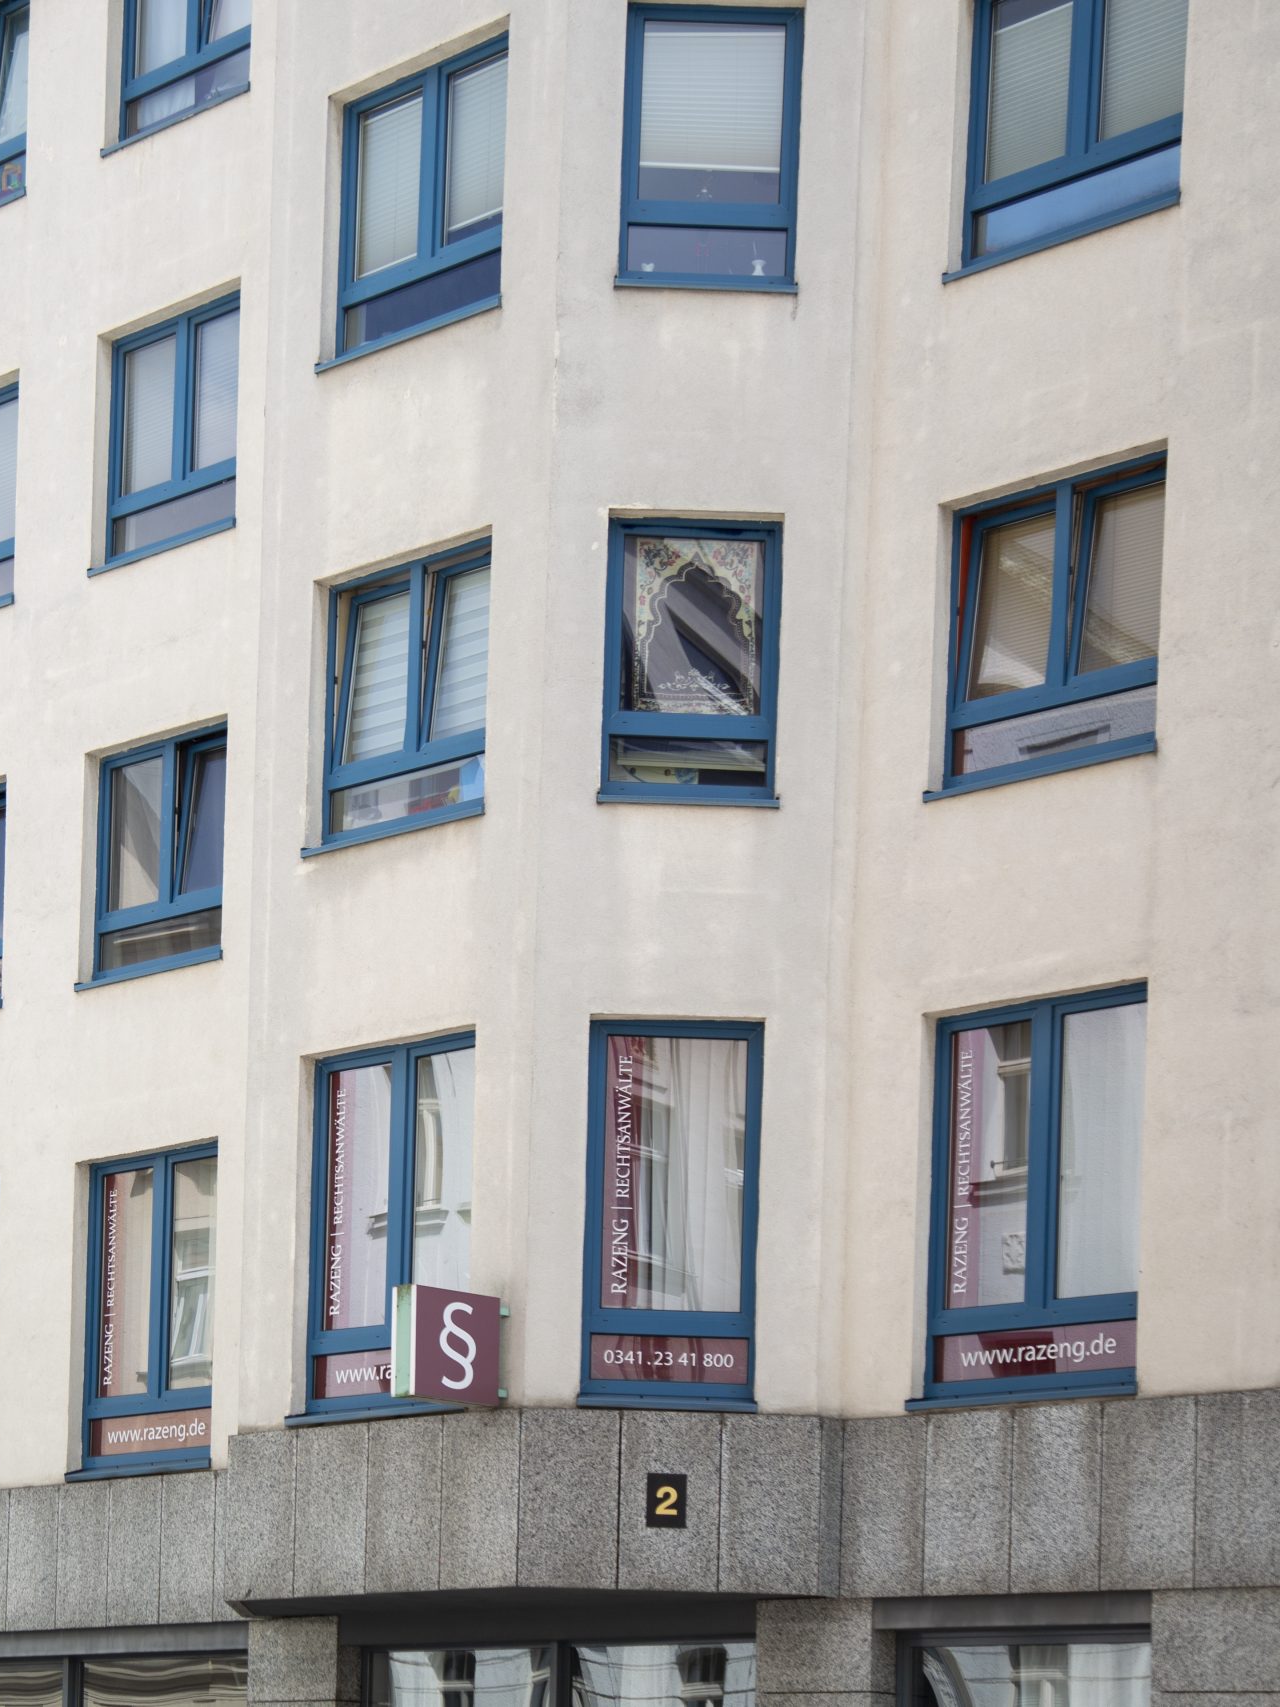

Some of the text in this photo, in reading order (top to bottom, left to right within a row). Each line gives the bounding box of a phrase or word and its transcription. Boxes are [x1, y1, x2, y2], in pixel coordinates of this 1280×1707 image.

[328, 1088, 347, 1317] RAZENG RECHTSANWÄLTE
[611, 1055, 633, 1294] RAZENG RECHTSANWÄLTE
[953, 1049, 974, 1293] RAZENG RECHTSANWÄLTE
[103, 1189, 118, 1386] RAZENG RECHTSANWÄLTE
[678, 1352, 696, 1367] 41
[703, 1353, 734, 1368] 800
[961, 1333, 1117, 1368] www.razeng.de
[107, 1418, 206, 1444] www.razeng.de
[655, 1486, 678, 1516] 2
